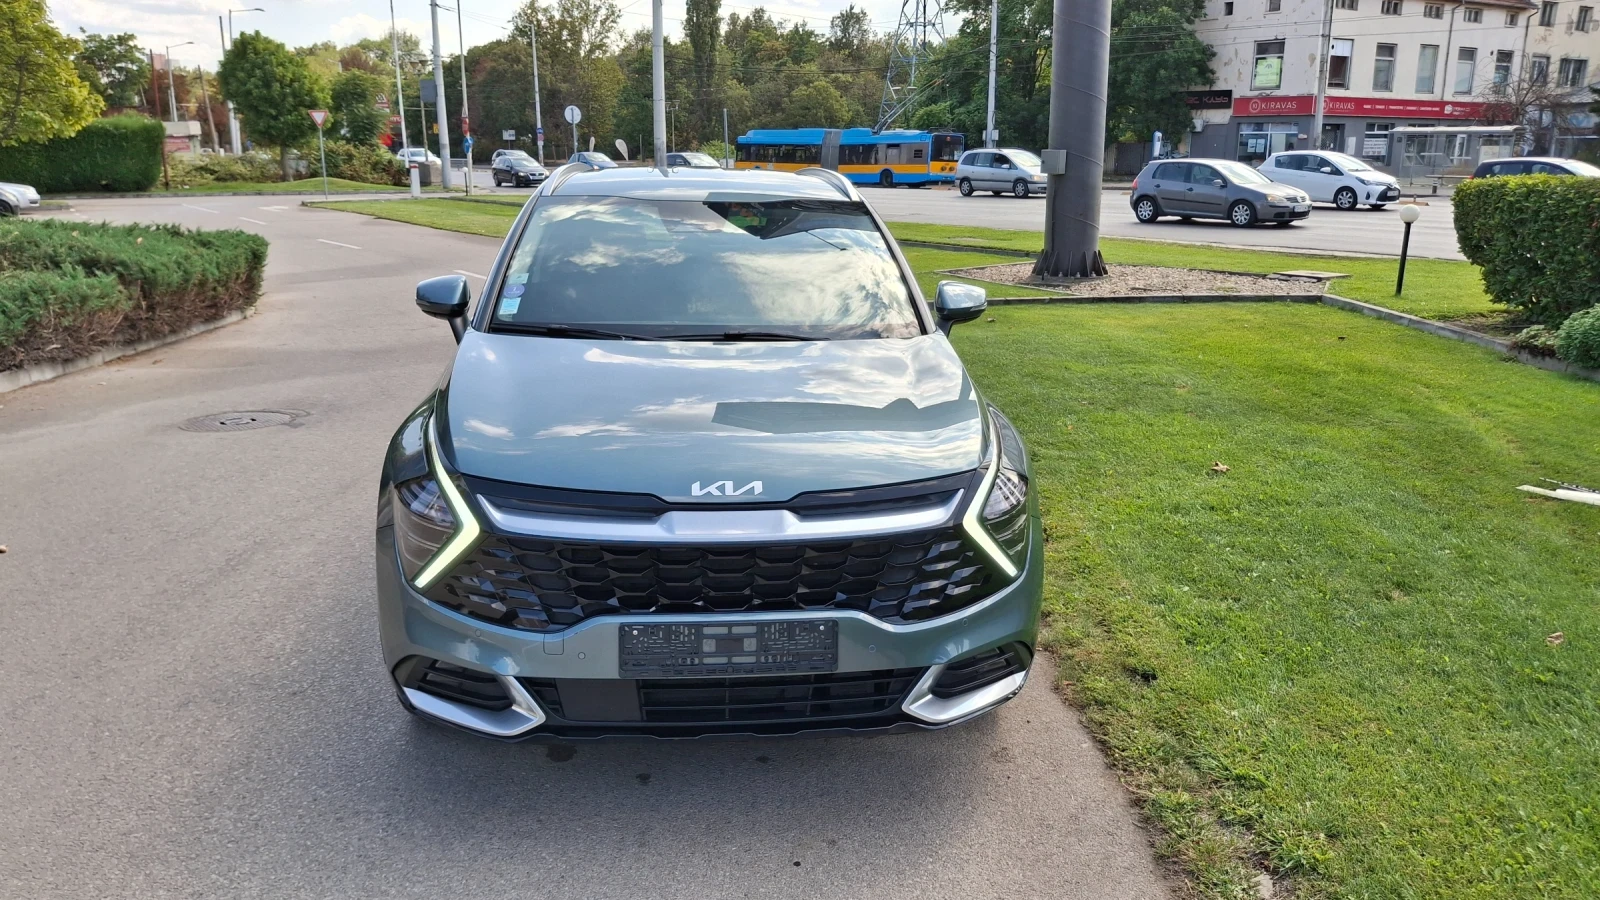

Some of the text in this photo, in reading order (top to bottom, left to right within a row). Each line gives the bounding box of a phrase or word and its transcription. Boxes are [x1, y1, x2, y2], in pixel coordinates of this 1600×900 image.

[1261, 101, 1297, 109] KIRAVAS
[1329, 101, 1355, 110] KIRAVAS
[692, 480, 763, 496] KIA
